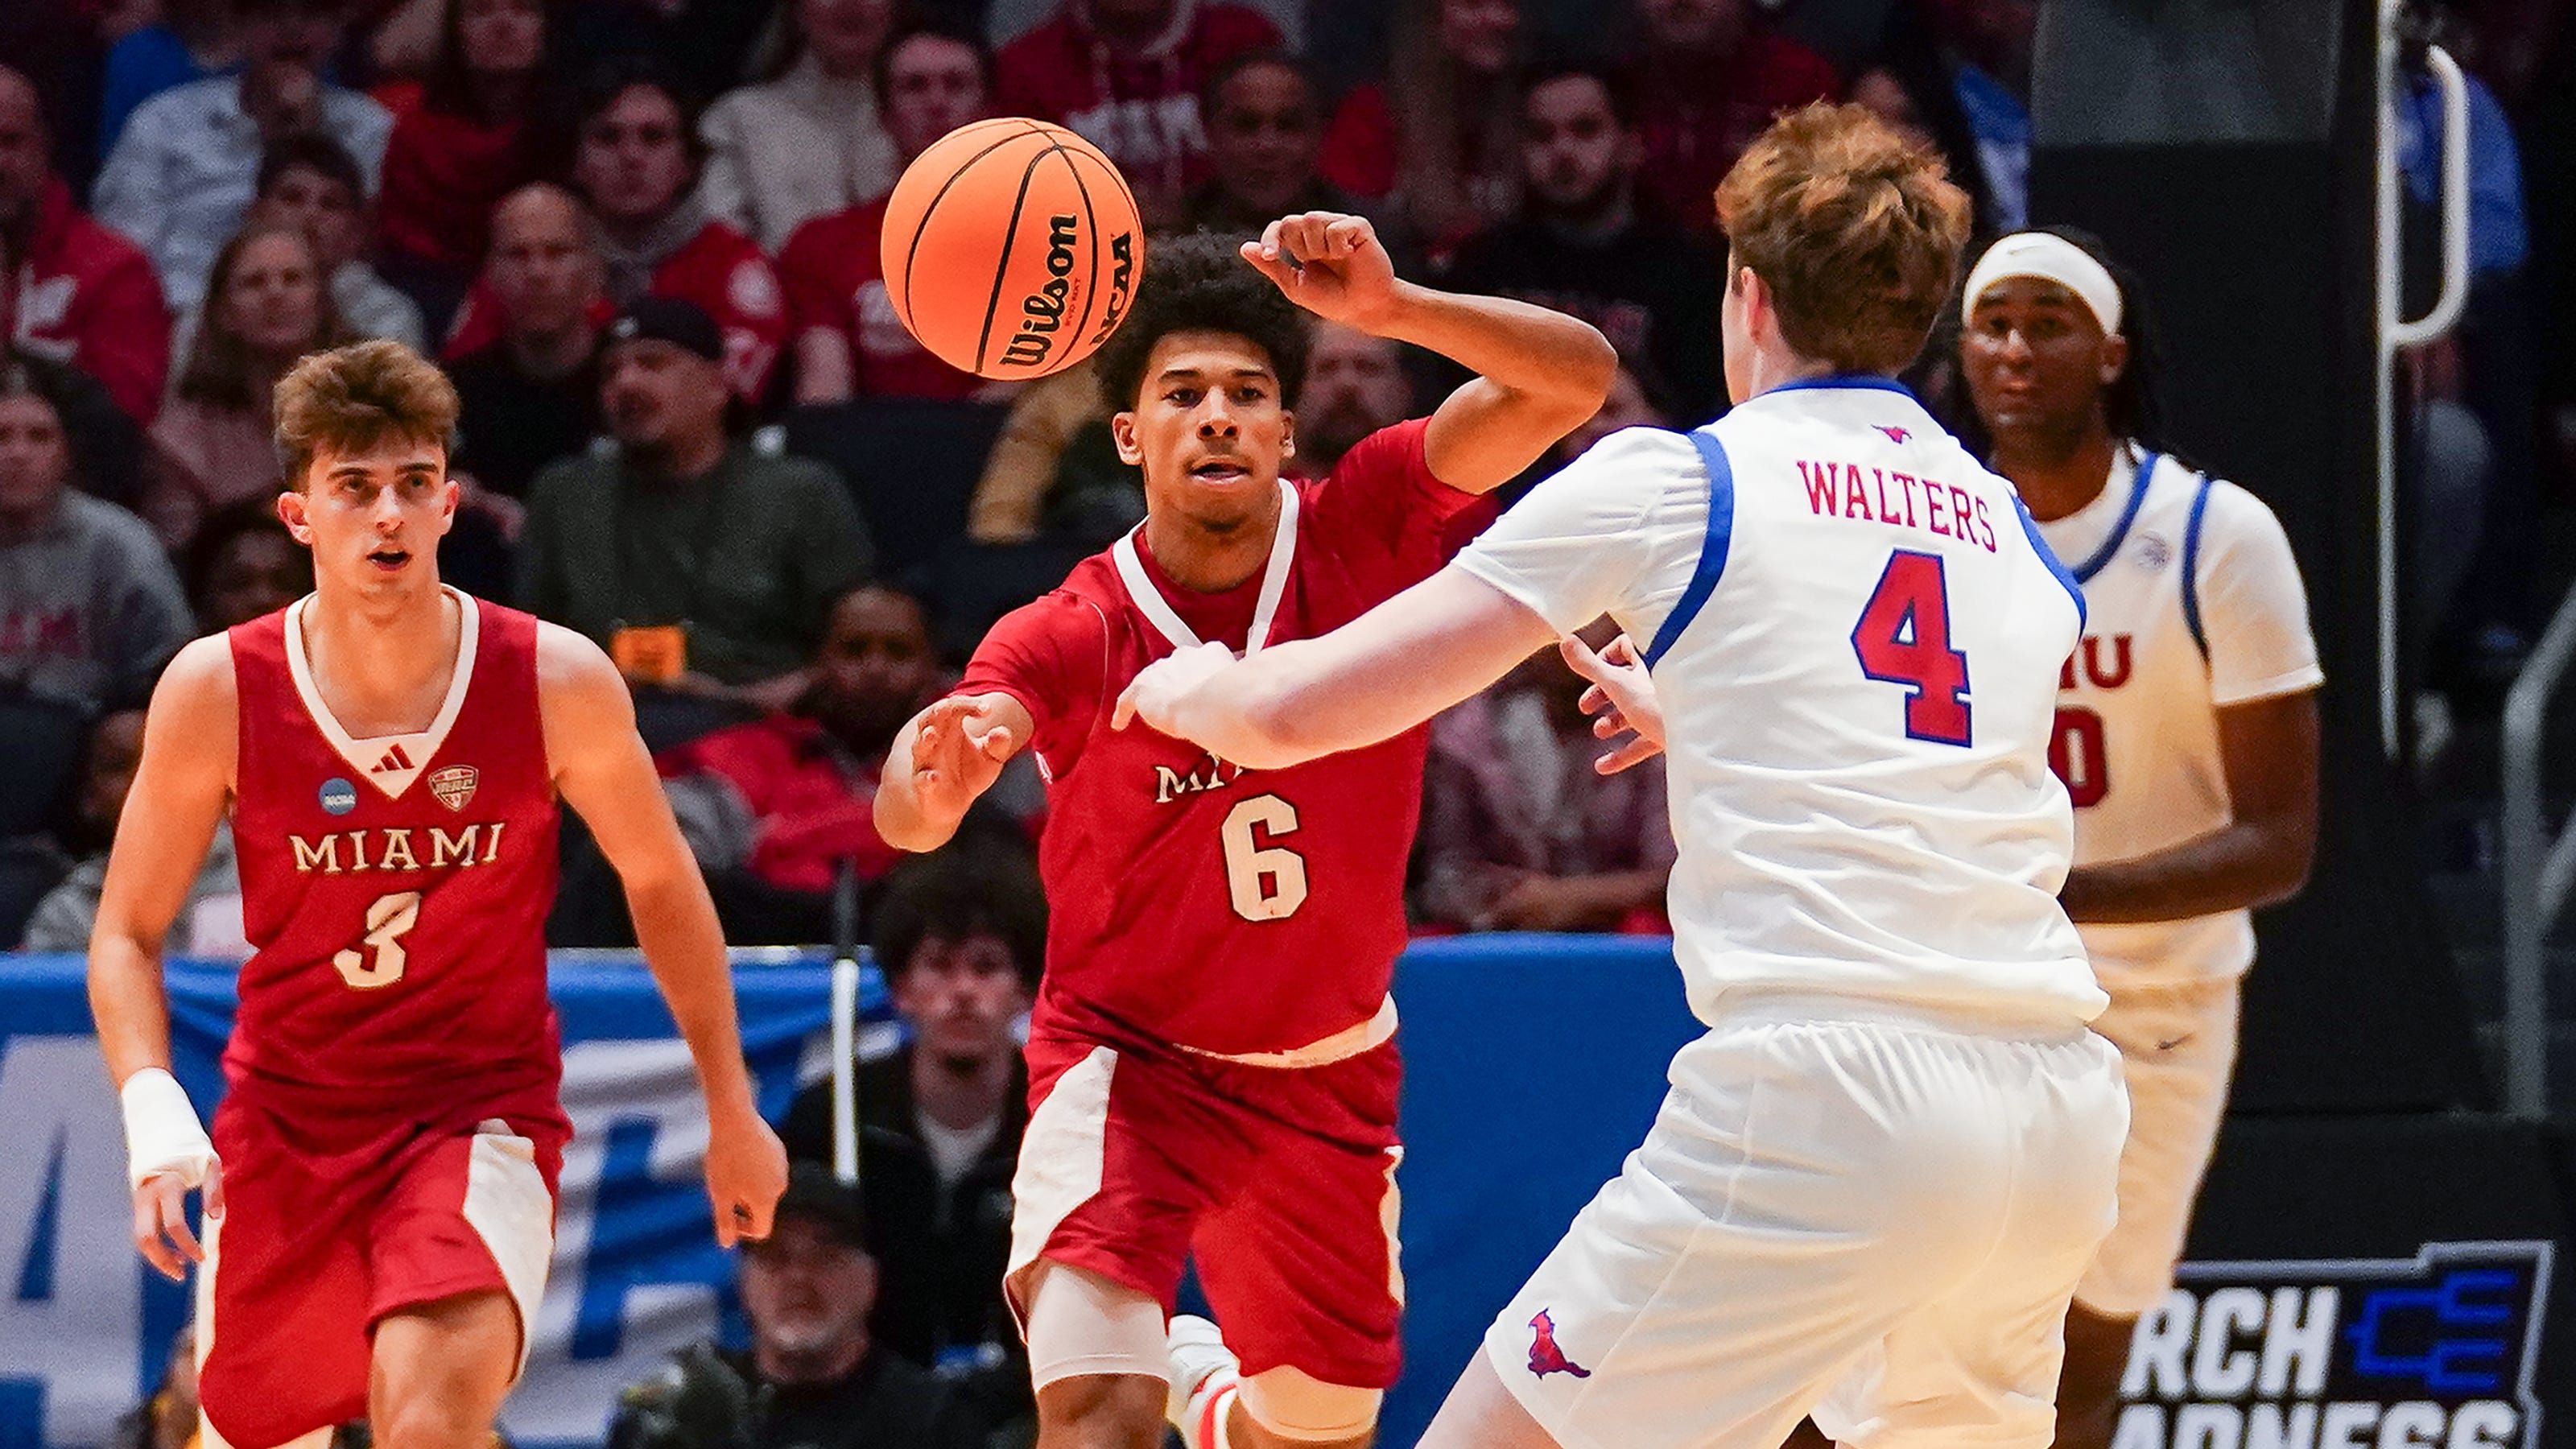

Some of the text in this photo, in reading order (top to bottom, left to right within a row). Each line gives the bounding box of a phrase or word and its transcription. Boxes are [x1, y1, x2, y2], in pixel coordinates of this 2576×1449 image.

[1000, 215, 1076, 365] Wilson
[1797, 460, 1996, 553] WALTERS
[1850, 547, 1971, 748] 4
[288, 823, 505, 873] MIAMI
[1221, 794, 1307, 922] 6
[332, 891, 422, 988] 3
[2117, 1286, 2341, 1400] RCH
